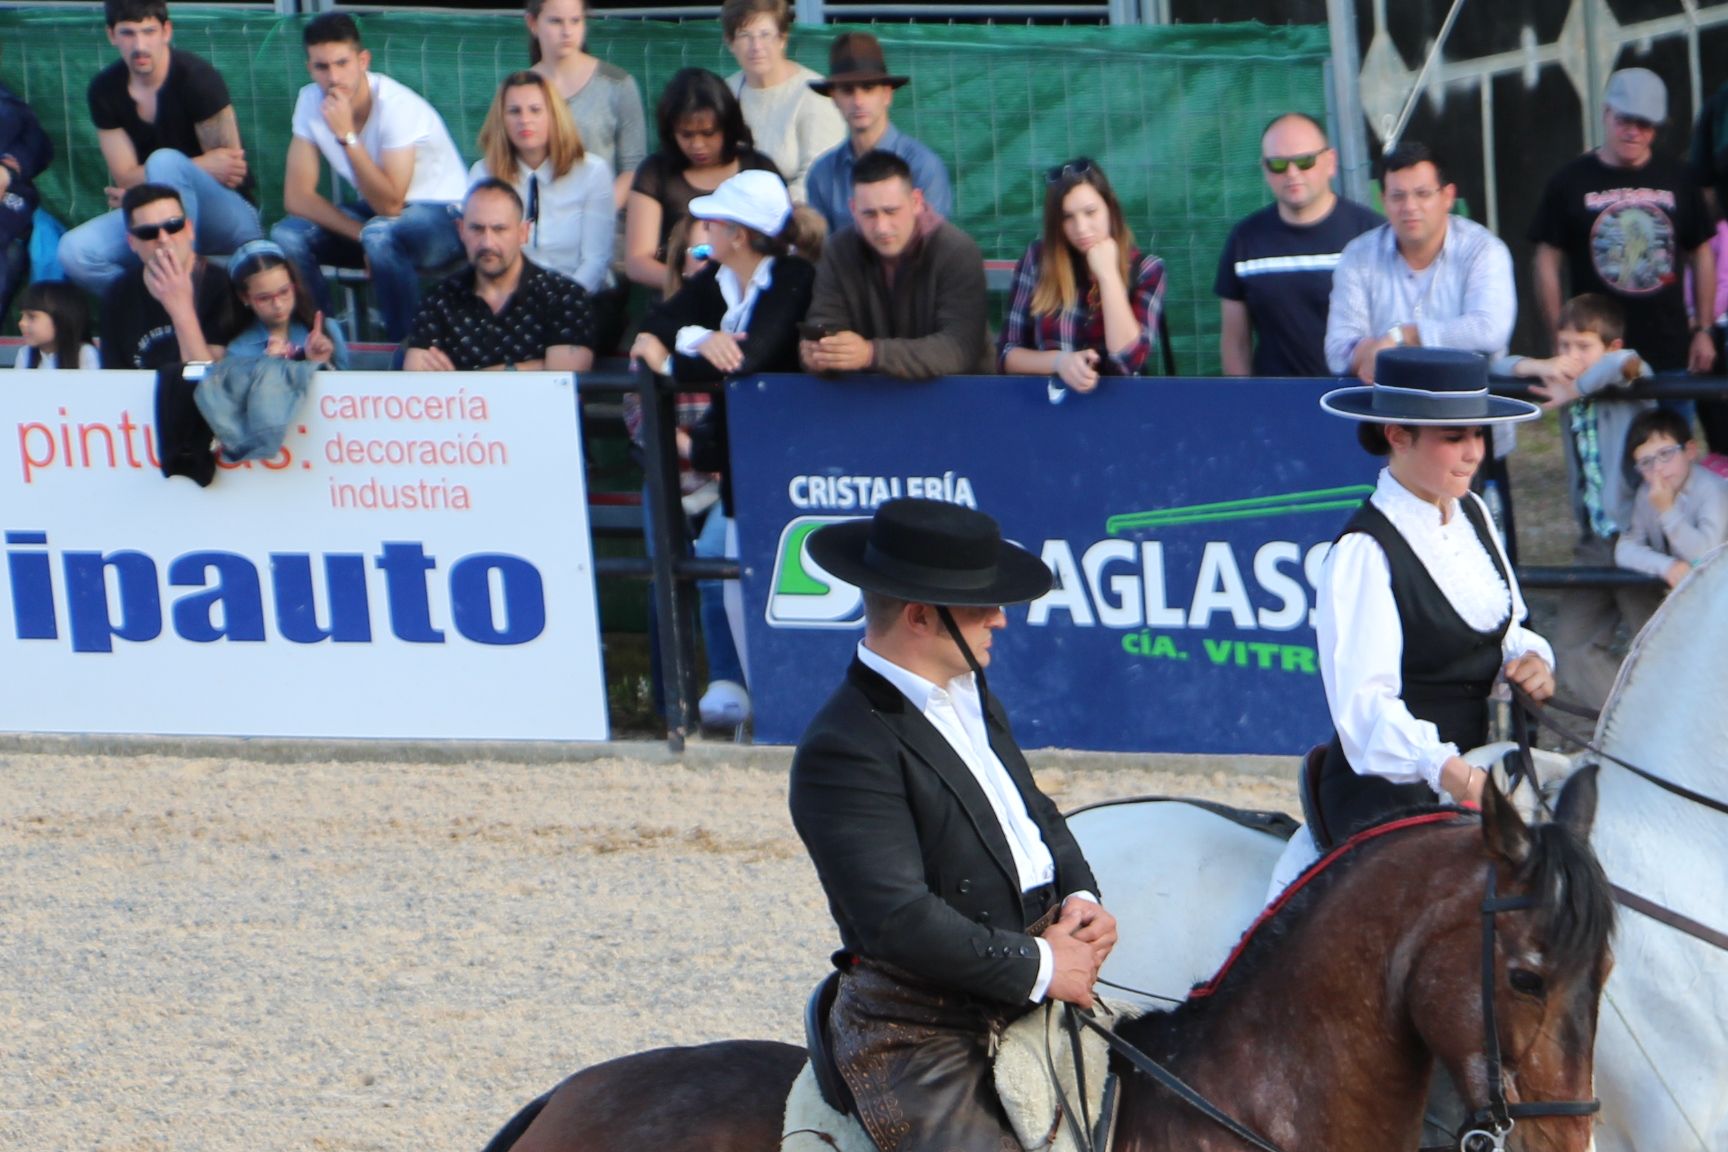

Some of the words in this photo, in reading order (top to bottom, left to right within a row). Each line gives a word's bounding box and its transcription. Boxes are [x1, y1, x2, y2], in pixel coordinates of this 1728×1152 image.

[319, 387, 488, 421] carrocería
[17, 407, 311, 484] pintu:
[324, 432, 508, 465] decoración
[329, 475, 470, 510] industria
[788, 470, 978, 510] CRISTALERÍA
[1203, 638, 1322, 675] VITR
